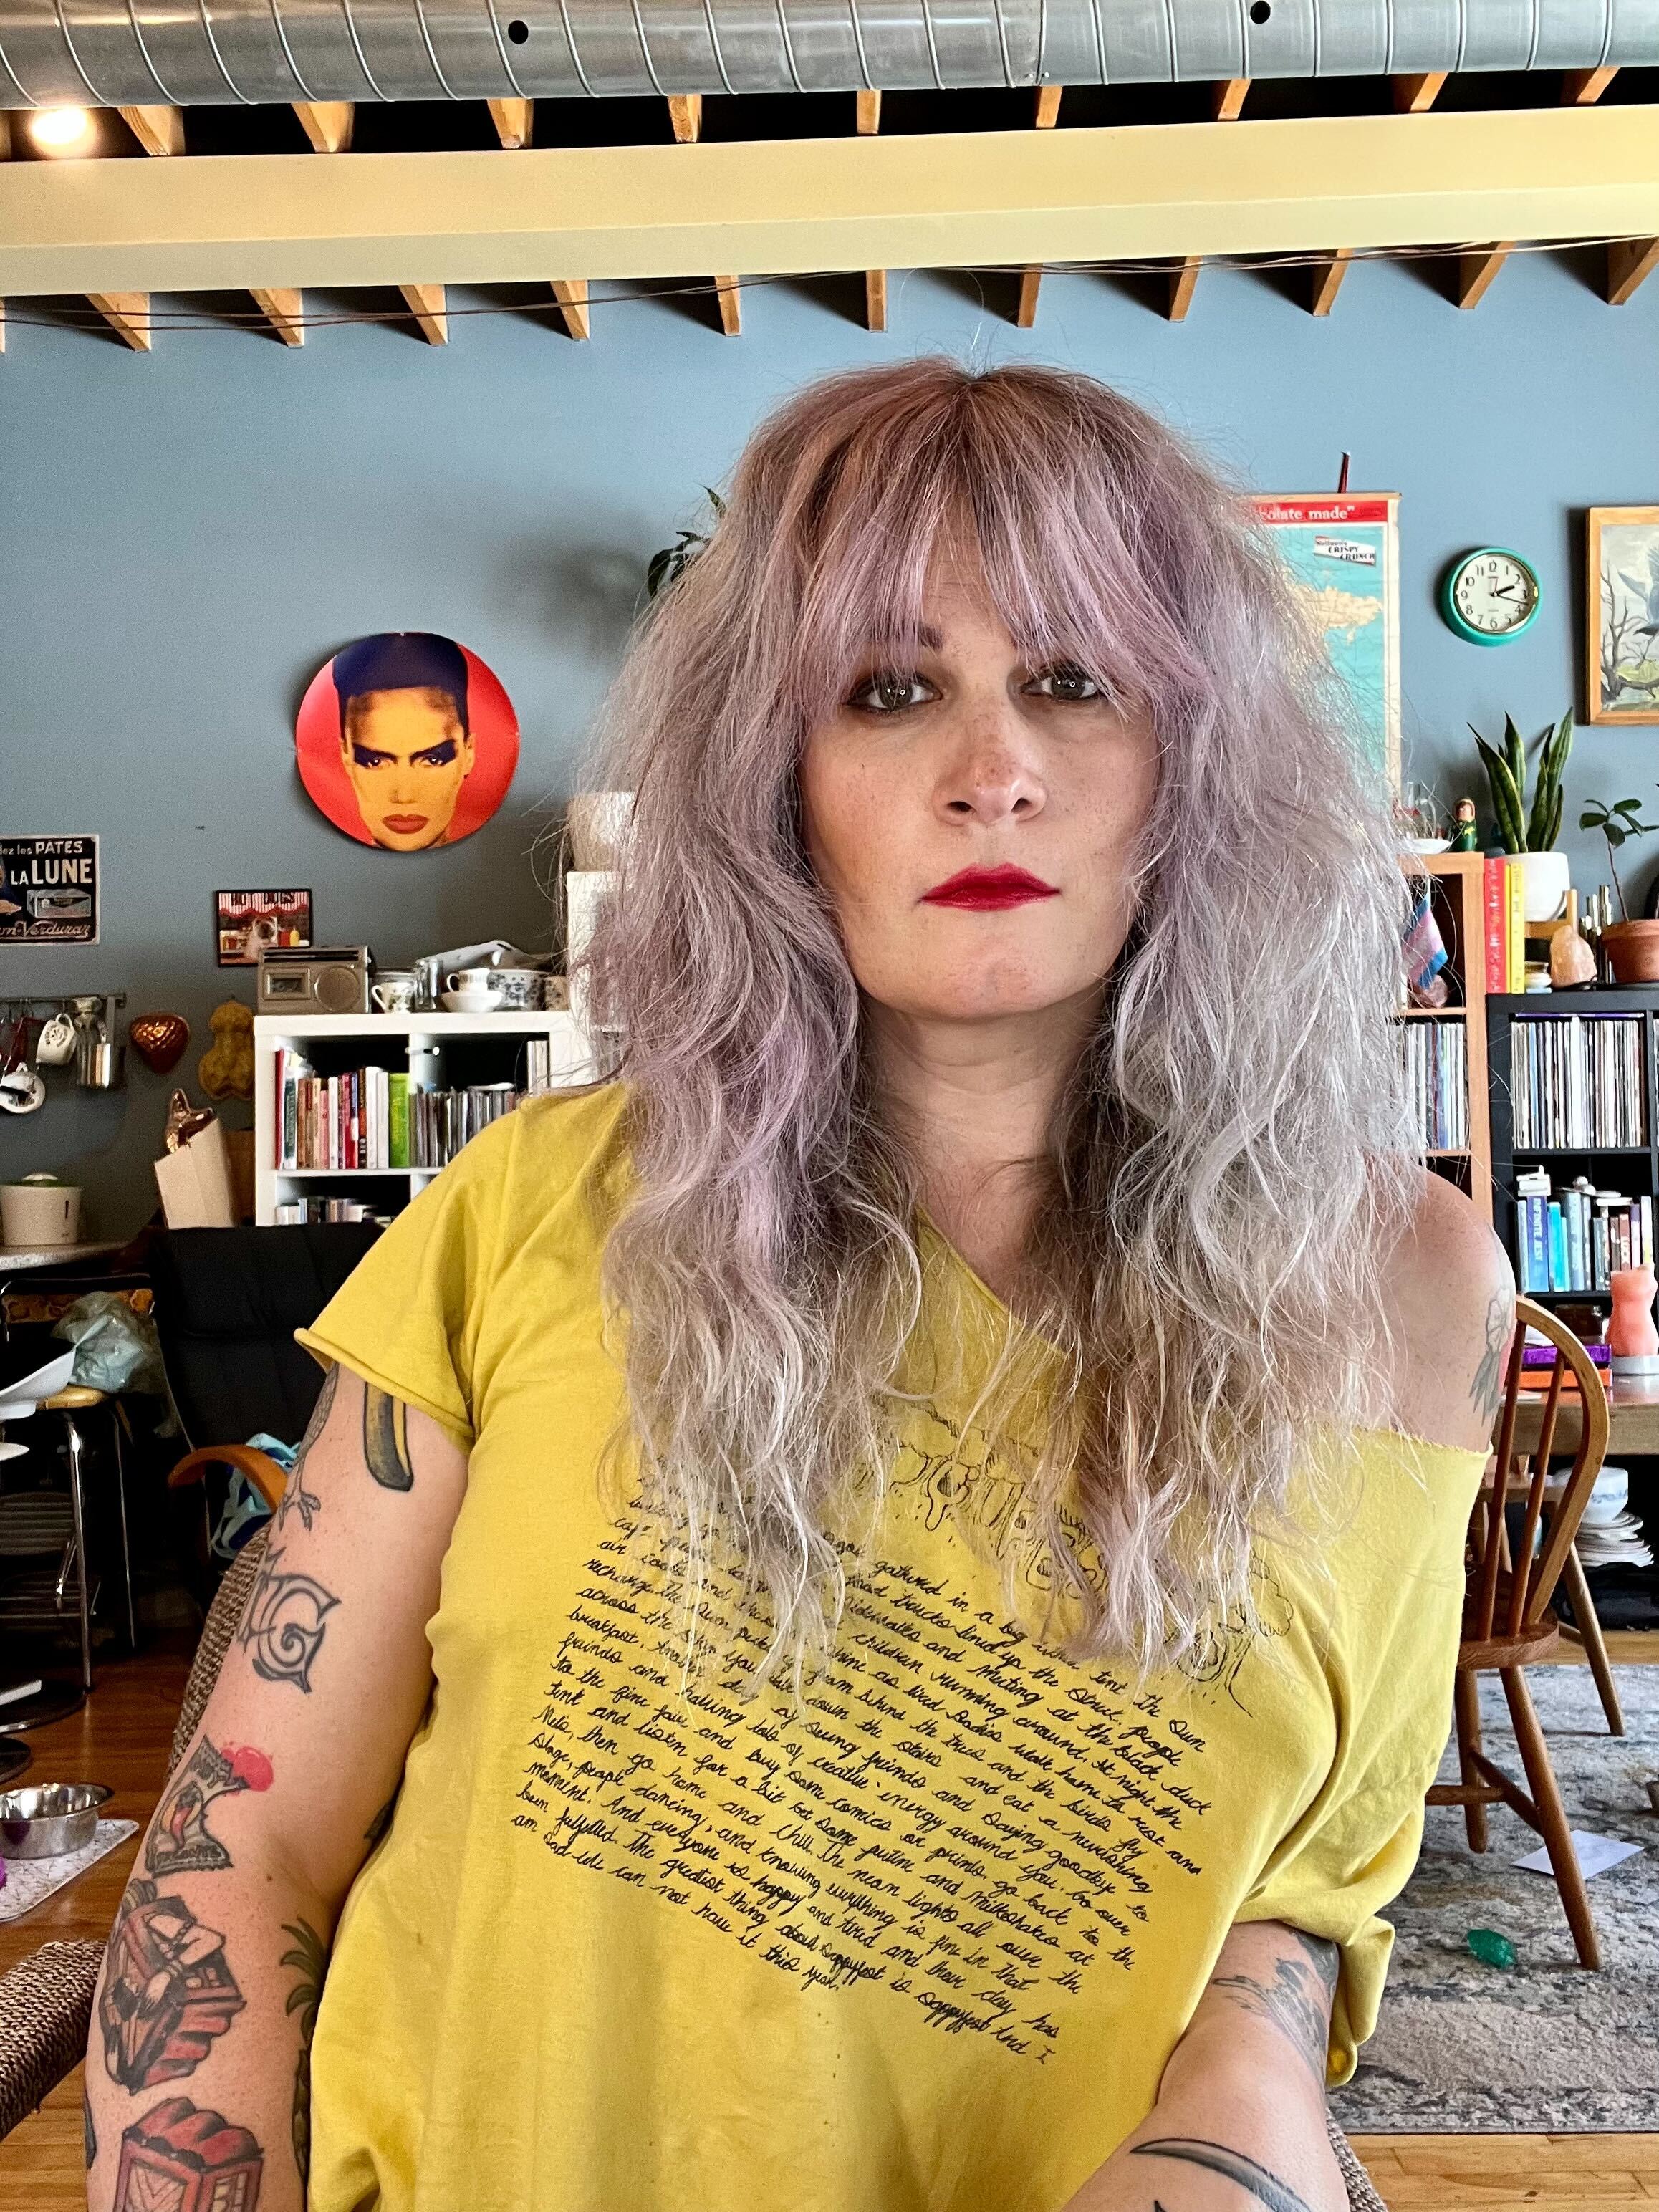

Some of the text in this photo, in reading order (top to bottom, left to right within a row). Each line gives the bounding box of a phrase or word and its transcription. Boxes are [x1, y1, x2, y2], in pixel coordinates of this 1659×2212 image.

[1461, 590, 1468, 600] 9
[1466, 576, 1475, 587] 10
[1466, 605, 1473, 615] 8
[1476, 565, 1484, 576] 11
[1478, 614, 1484, 625] 7
[1490, 617, 1498, 630] 6
[1505, 613, 1512, 625] 5
[1506, 565, 1509, 575] 1
[1514, 574, 1521, 585] 2
[1514, 605, 1524, 614] 4
[11, 858, 92, 885] LA LUNE
[17, 844, 32, 855] les
[575, 1587, 639, 1614] across
[640, 1609, 673, 1630] the
[855, 1718, 883, 1739] the
[891, 1741, 942, 1768] stairs
[959, 1776, 1004, 1795] and
[1002, 1794, 1035, 1812] eat
[1038, 1816, 1061, 1832] a
[596, 1537, 627, 1555] air
[867, 1671, 900, 1690] as
[1054, 1766, 1102, 1800] home
[1127, 1817, 1166, 1847] rest
[1165, 1849, 1201, 1875] and
[948, 1592, 969, 1612] in
[973, 1611, 994, 1625] a
[994, 1619, 1029, 1648] big
[1089, 1670, 1128, 1696] tent
[1132, 1692, 1163, 1718] the
[994, 1651, 1026, 1683] up
[1028, 1666, 1059, 1687] the
[1117, 1726, 1183, 1768] people
[847, 1633, 924, 1675] children
[920, 1670, 1011, 1728] running
[1107, 1774, 1157, 1807] night
[1151, 1805, 1183, 1831] the
[854, 1688, 907, 1721] behind
[908, 1718, 939, 1739] the
[940, 1733, 986, 1762] trees
[986, 1762, 1029, 1782] and
[1026, 1779, 1055, 1799] the
[1059, 1799, 1112, 1832] birds
[1108, 1837, 1149, 1870] fly
[922, 1642, 1212, 1816] and at the black duck
[543, 1680, 1095, 1966] tent and listen for a bit and at
[549, 1655, 576, 1675] to
[575, 1667, 605, 1688] the
[693, 1728, 738, 1750] and
[744, 1747, 782, 1781] buy
[825, 1797, 892, 1832] comics
[899, 1833, 926, 1848] or
[1022, 1893, 1072, 1925] back
[1079, 1925, 1100, 1947] to
[1107, 1946, 1135, 1971] the
[576, 1724, 618, 1756] then
[624, 1753, 656, 1776] go
[662, 1766, 707, 1799] home
[718, 1802, 766, 1827] and
[816, 1834, 851, 1869] The
[901, 1890, 959, 1923] lights
[956, 1920, 994, 1938] all
[995, 1942, 1042, 1968] over
[1047, 1969, 1082, 1995] the
[628, 1665, 669, 1687] and
[675, 1684, 747, 1728] having
[780, 1742, 805, 1767] of
[877, 1792, 947, 1834] energy
[946, 1827, 1019, 1861] around
[1094, 1909, 1131, 1937] over
[770, 1707, 799, 1731] of
[931, 1790, 976, 1812] and
[1038, 1850, 1117, 1896] goodbye
[1125, 1904, 1150, 1923] to
[510, 1814, 538, 1832] am
[607, 1866, 647, 1888] can
[649, 1885, 691, 1905] not
[691, 1902, 733, 1933] have
[735, 1933, 763, 1948] it
[759, 1943, 802, 1972] this
[515, 1779, 549, 1813] been
[622, 1829, 656, 1860] The
[659, 1859, 726, 1893] greatest
[722, 1889, 770, 1930] thing
[889, 1971, 913, 1994] is
[1035, 2044, 1056, 2065] I
[572, 1761, 625, 1793] people
[714, 1828, 758, 1855] and
[755, 1846, 822, 1899] knowing
[900, 1919, 926, 1941] is
[925, 1935, 962, 1956] fine
[962, 1946, 990, 1969] in
[991, 1962, 1040, 1991] that
[644, 1820, 721, 1861] everyone
[723, 1862, 751, 1880] is
[749, 1873, 807, 1917] happy
[806, 1905, 835, 1927] and
[835, 1915, 882, 1949] tired
[880, 1945, 924, 1968] and
[970, 1989, 1017, 2021] day
[1020, 2012, 1059, 2039] has
